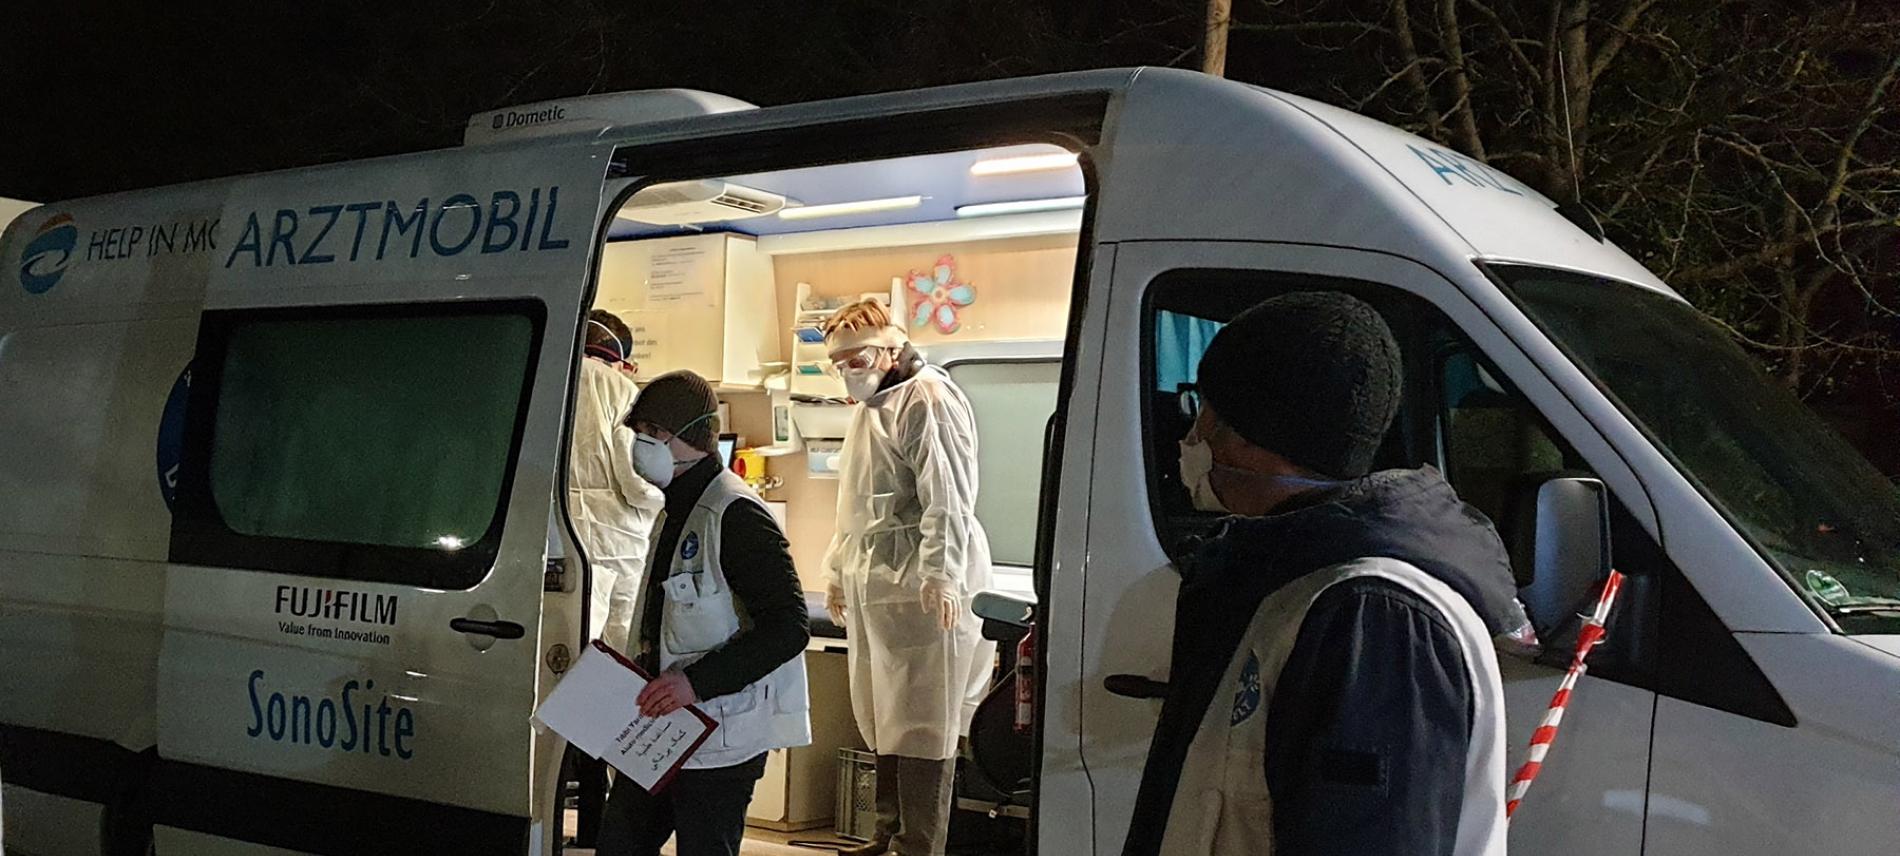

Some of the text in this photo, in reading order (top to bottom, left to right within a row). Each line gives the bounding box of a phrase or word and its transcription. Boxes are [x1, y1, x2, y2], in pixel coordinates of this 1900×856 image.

[506, 104, 565, 127] Dometic
[88, 225, 143, 261] HELP
[148, 222, 178, 256] IN
[225, 186, 570, 268] ARZTMOBIL
[275, 585, 398, 625] FUJIFILM
[279, 621, 391, 645] Value from Innovation
[247, 669, 414, 760] SonoSite
